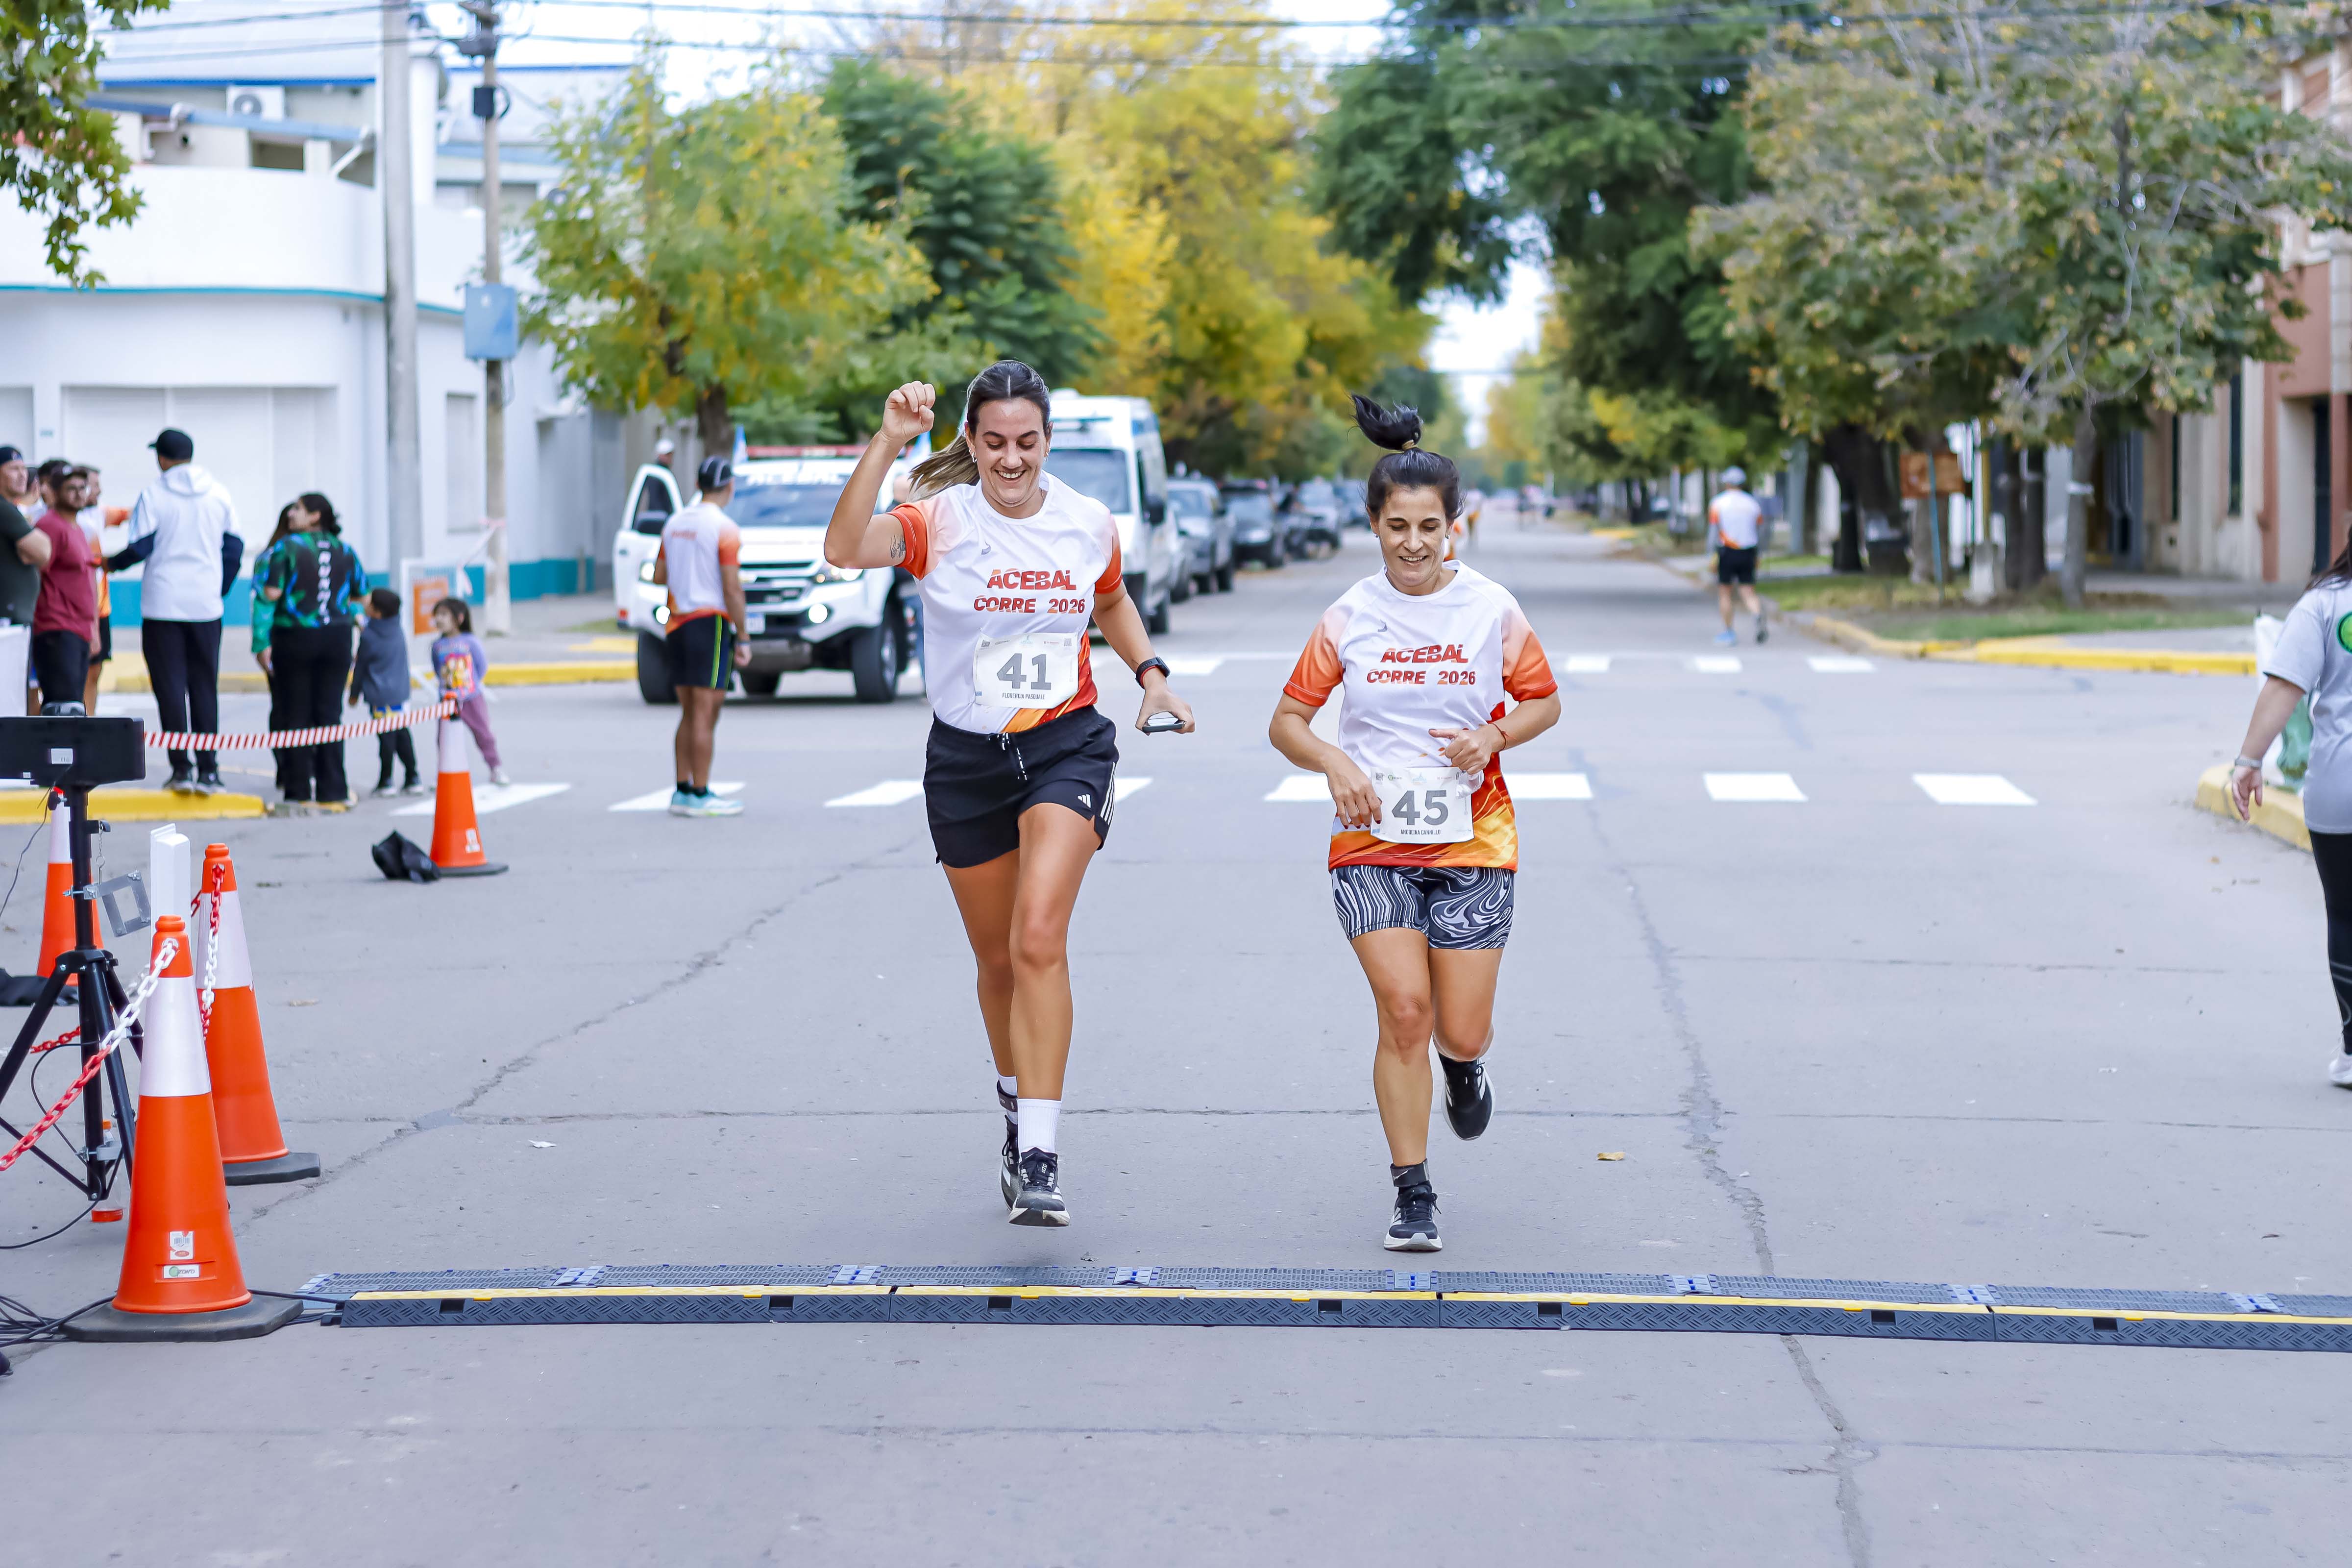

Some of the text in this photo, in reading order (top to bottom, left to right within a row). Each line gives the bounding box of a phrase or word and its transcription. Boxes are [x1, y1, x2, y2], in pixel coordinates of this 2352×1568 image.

[987, 568, 1077, 590] ACEBAL
[974, 595, 1084, 613] CORRE 2026
[1380, 644, 1469, 663] ACEBAL
[997, 653, 1051, 690] 41
[1367, 669, 1476, 685] CORRE 2026
[1392, 790, 1448, 826] 45
